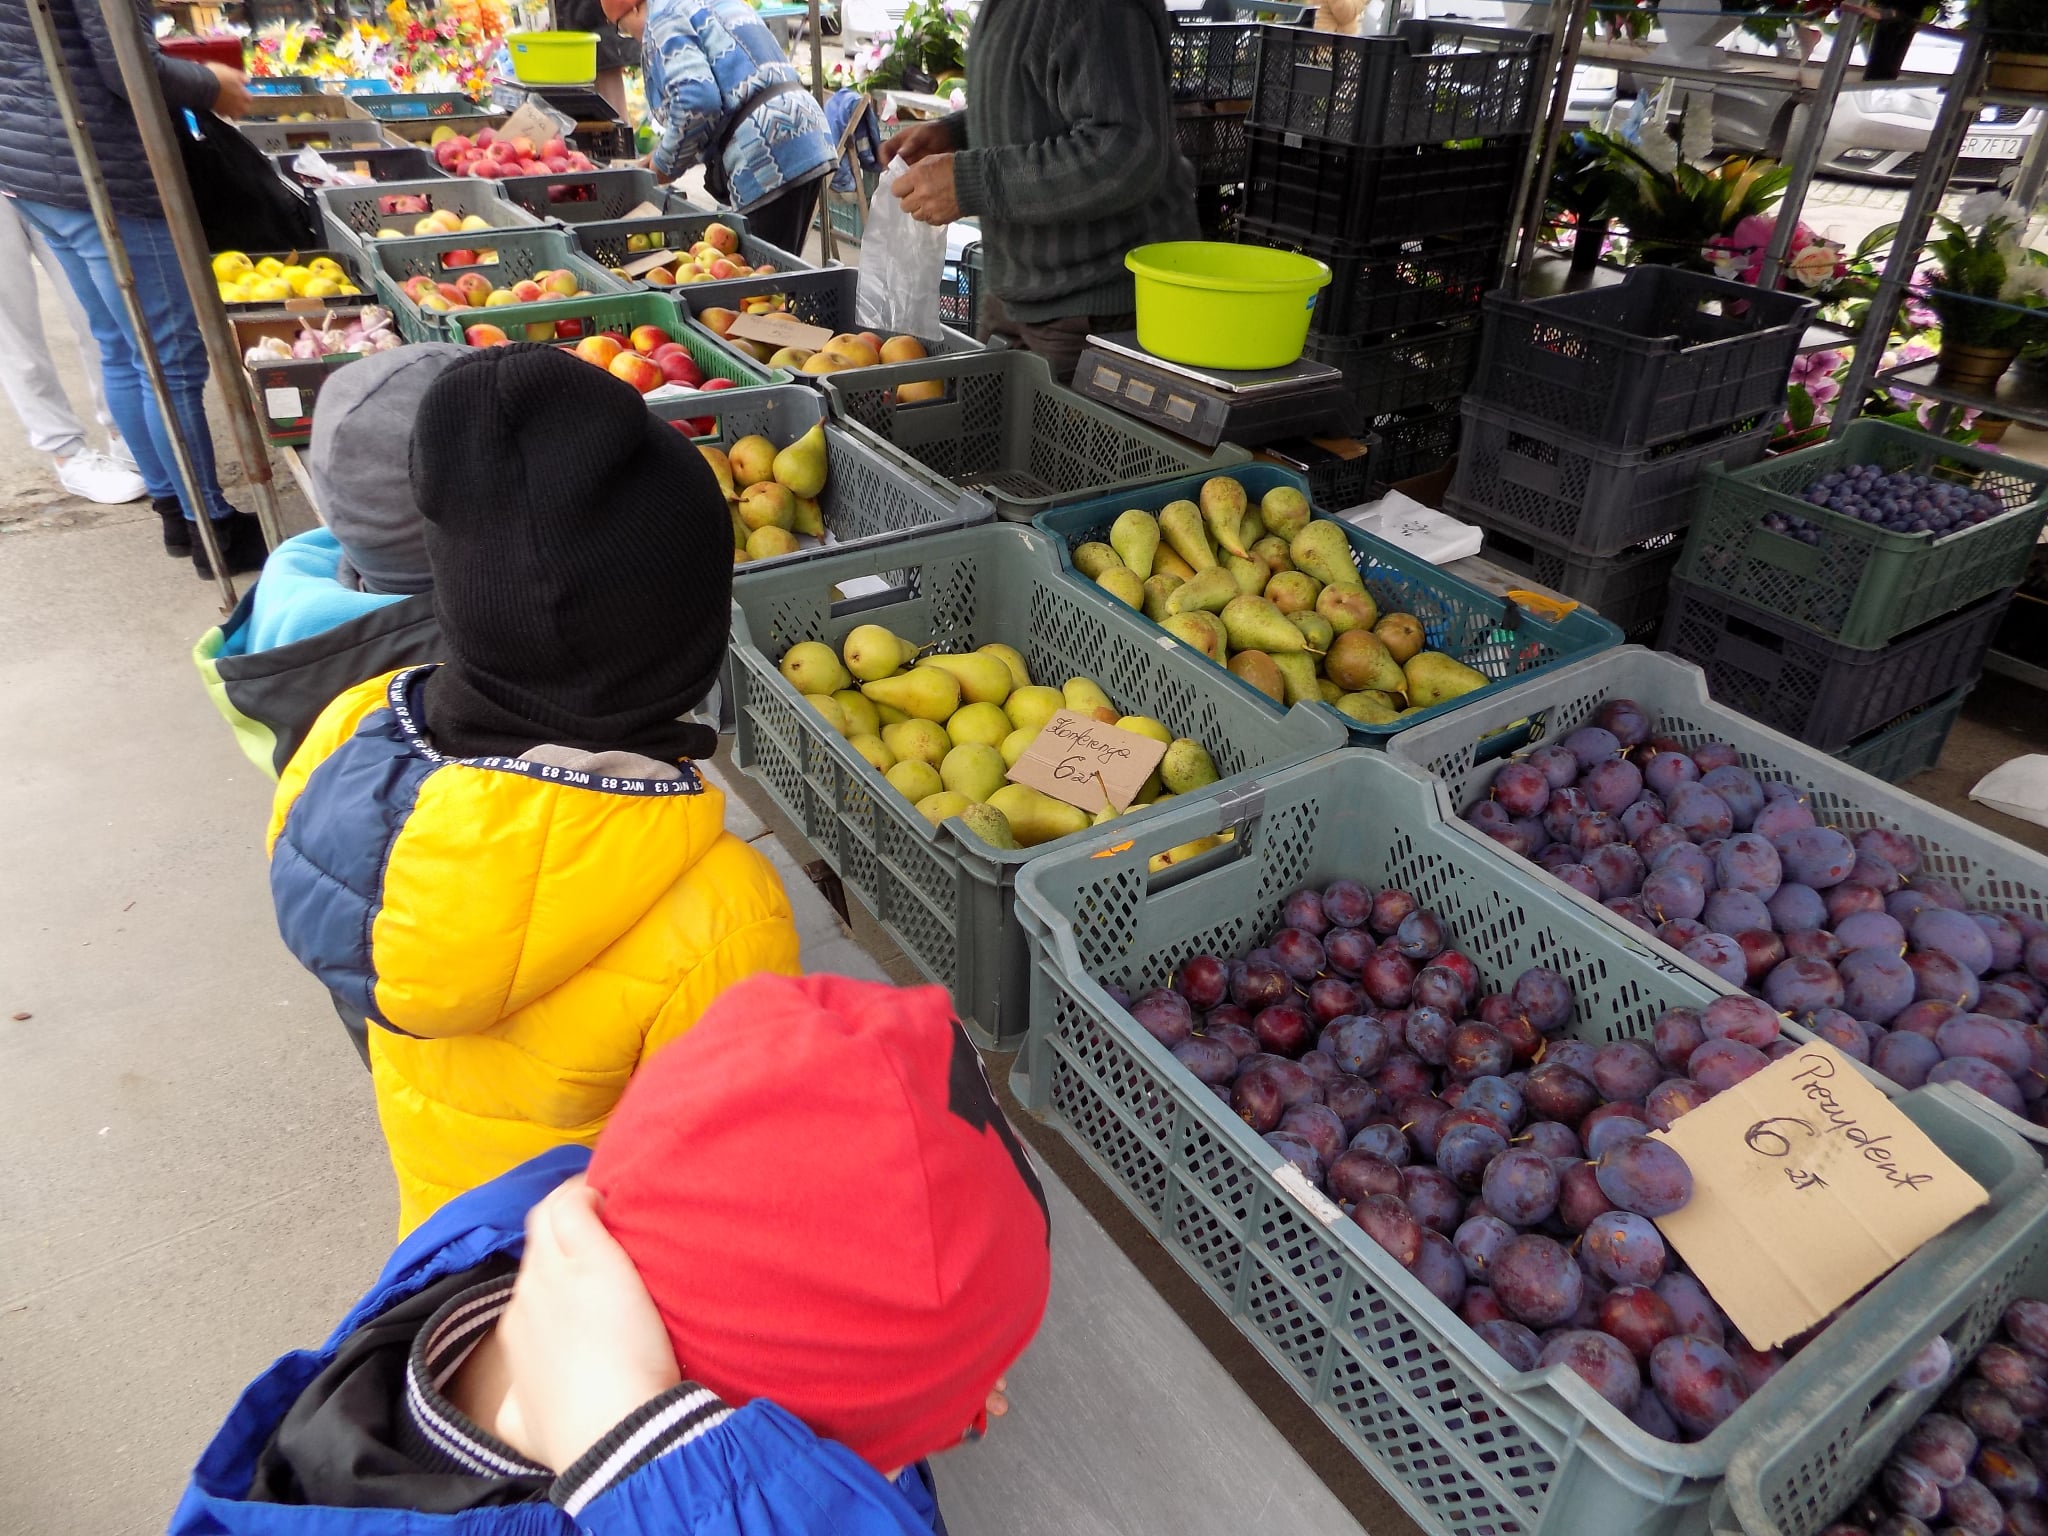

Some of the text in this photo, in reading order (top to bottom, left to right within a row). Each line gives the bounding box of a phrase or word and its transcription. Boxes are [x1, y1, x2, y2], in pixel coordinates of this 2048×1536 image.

[1981, 138, 2018, 154] 7FT2
[503, 758, 530, 772] NYC
[542, 766, 590, 784] NYC 83
[602, 777, 644, 792] NYC 83
[654, 781, 690, 792] NYC 83
[1791, 1053, 1934, 1192] Prezydent
